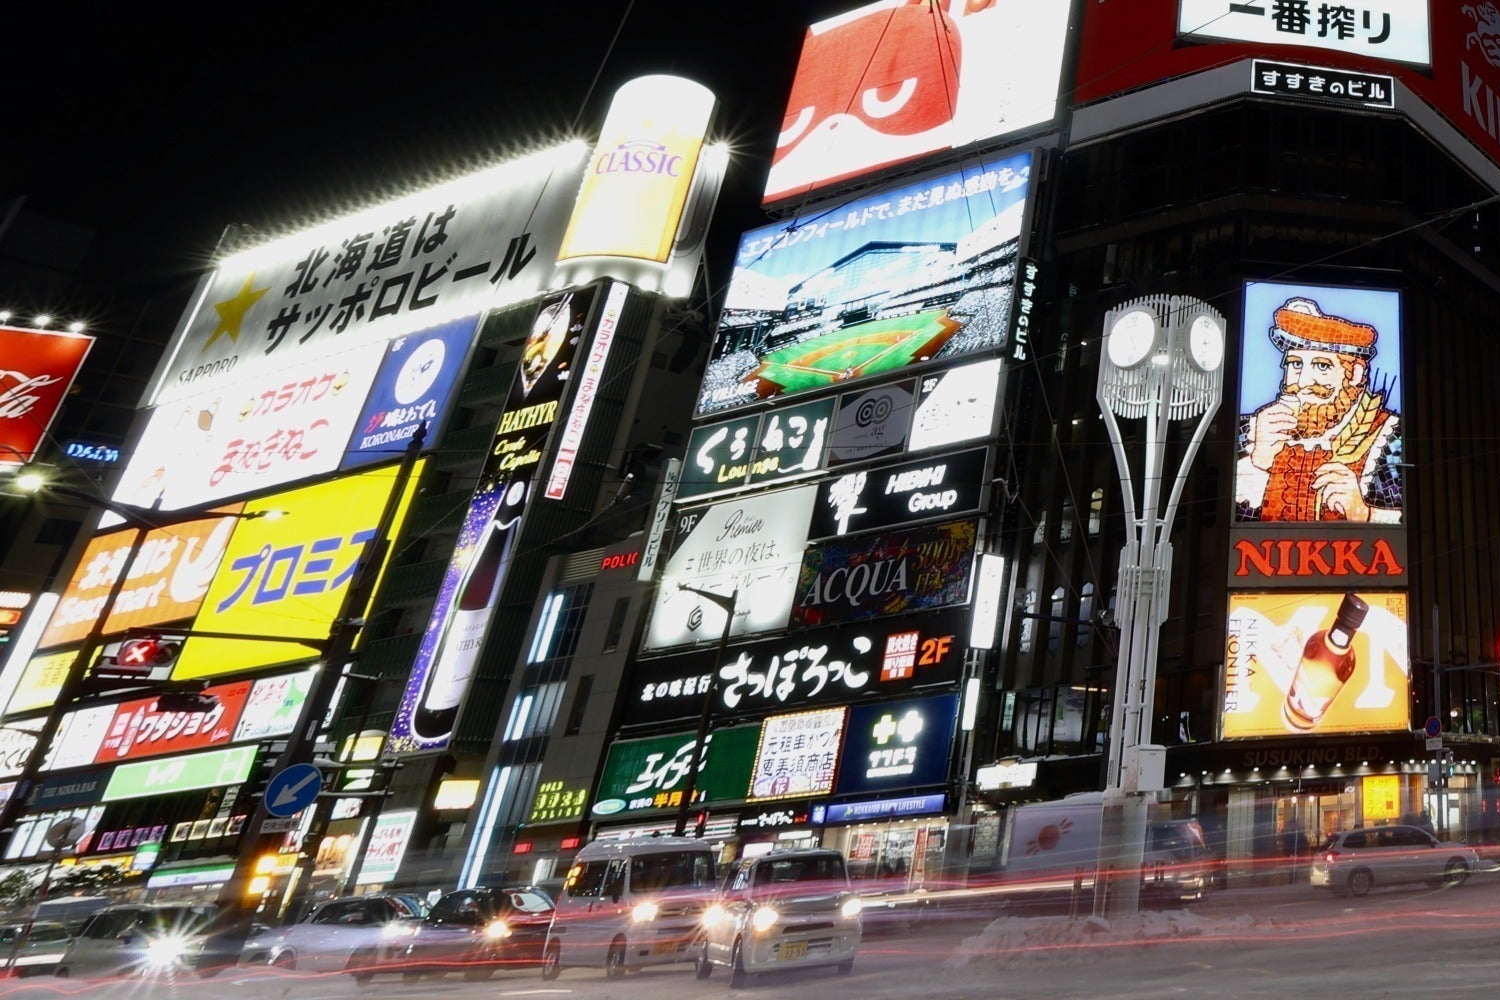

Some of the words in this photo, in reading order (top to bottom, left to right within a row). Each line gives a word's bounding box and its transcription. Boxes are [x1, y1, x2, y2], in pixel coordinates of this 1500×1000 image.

[1261, 71, 1386, 100] すすきのビル
[595, 151, 684, 177] CLASSIC
[284, 203, 458, 299] 北海道は
[264, 231, 538, 357] サッポロビール
[177, 353, 239, 386] SAPPORO
[252, 373, 337, 416] カラオケ
[922, 377, 939, 394] 2F
[497, 400, 559, 436] HATHYR
[360, 421, 431, 450] KORONAGIRI
[209, 418, 329, 488] まねきねこ
[716, 455, 780, 484] Lounge
[680, 513, 698, 534] 9F
[217, 528, 378, 615] プロミス
[601, 551, 640, 570] POLIC
[1233, 538, 1404, 577] NIKKA
[800, 556, 908, 607] ACQUA
[919, 637, 953, 666] 2F
[1245, 617, 1258, 678] NIKKA
[719, 636, 873, 708] さっぽろっこ
[1224, 618, 1242, 713] FRONTIER
[640, 675, 713, 702] 北の味紀行
[759, 751, 834, 777] 恵美須商店
[1243, 747, 1338, 768] SUSUKINO
[1344, 745, 1386, 764] BLD.
[898, 799, 926, 812] LIFESTYLE
